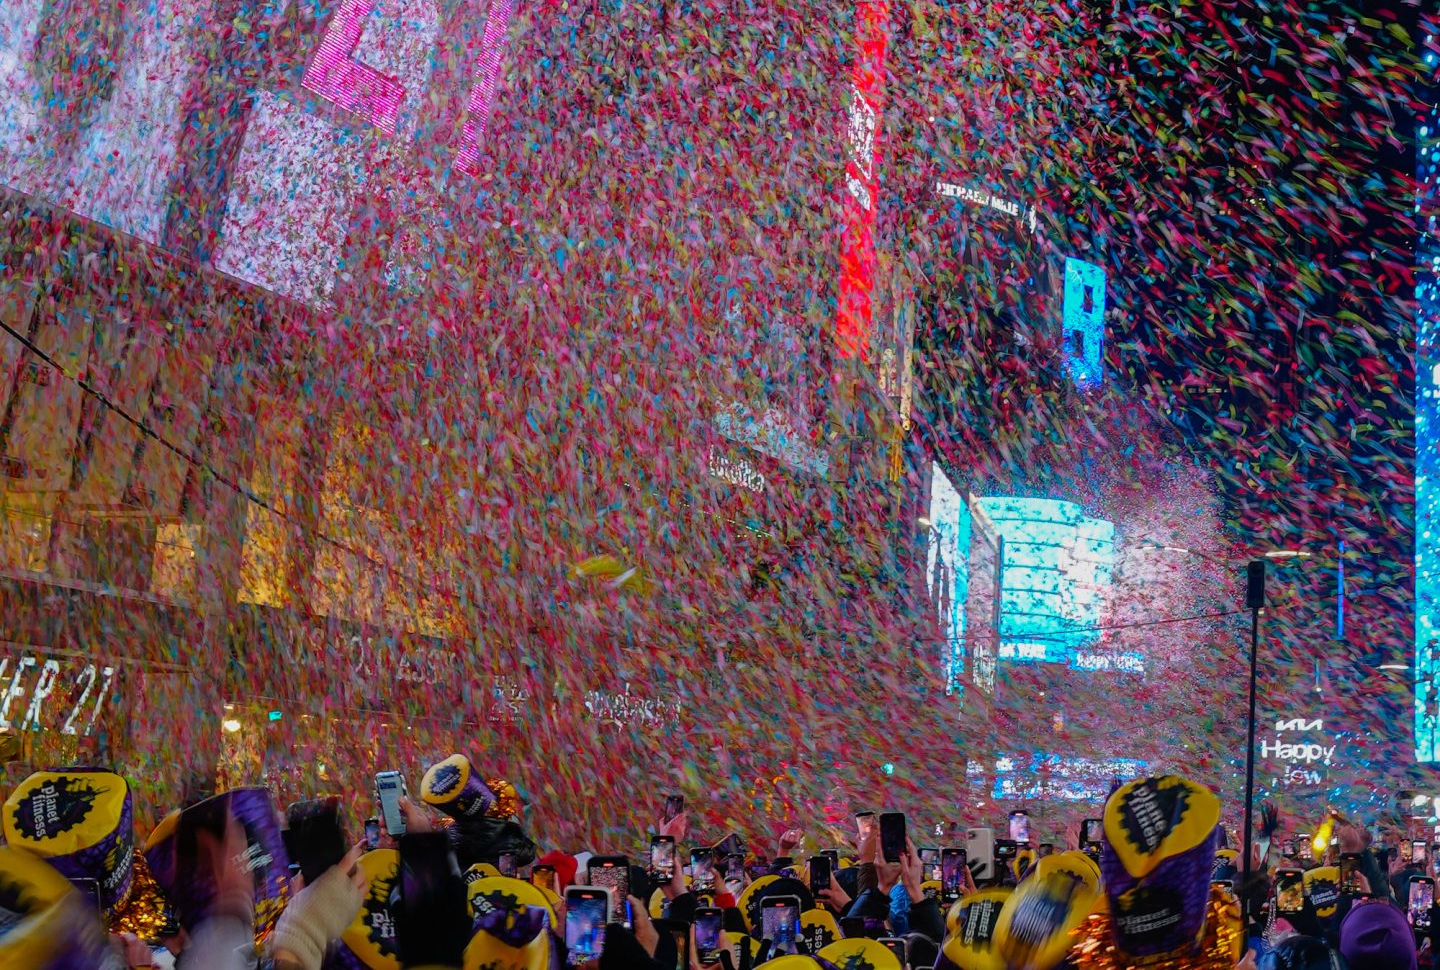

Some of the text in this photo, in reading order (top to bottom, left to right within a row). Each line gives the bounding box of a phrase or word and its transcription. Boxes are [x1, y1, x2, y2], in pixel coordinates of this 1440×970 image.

[61, 663, 114, 736] 21
[1261, 739, 1336, 766] Happy
[32, 793, 47, 838] fitness
[41, 784, 60, 824] planet
[1132, 786, 1169, 832] plane
[964, 902, 981, 944] fitness
[978, 899, 994, 938] planet
[1117, 906, 1171, 926] planet
